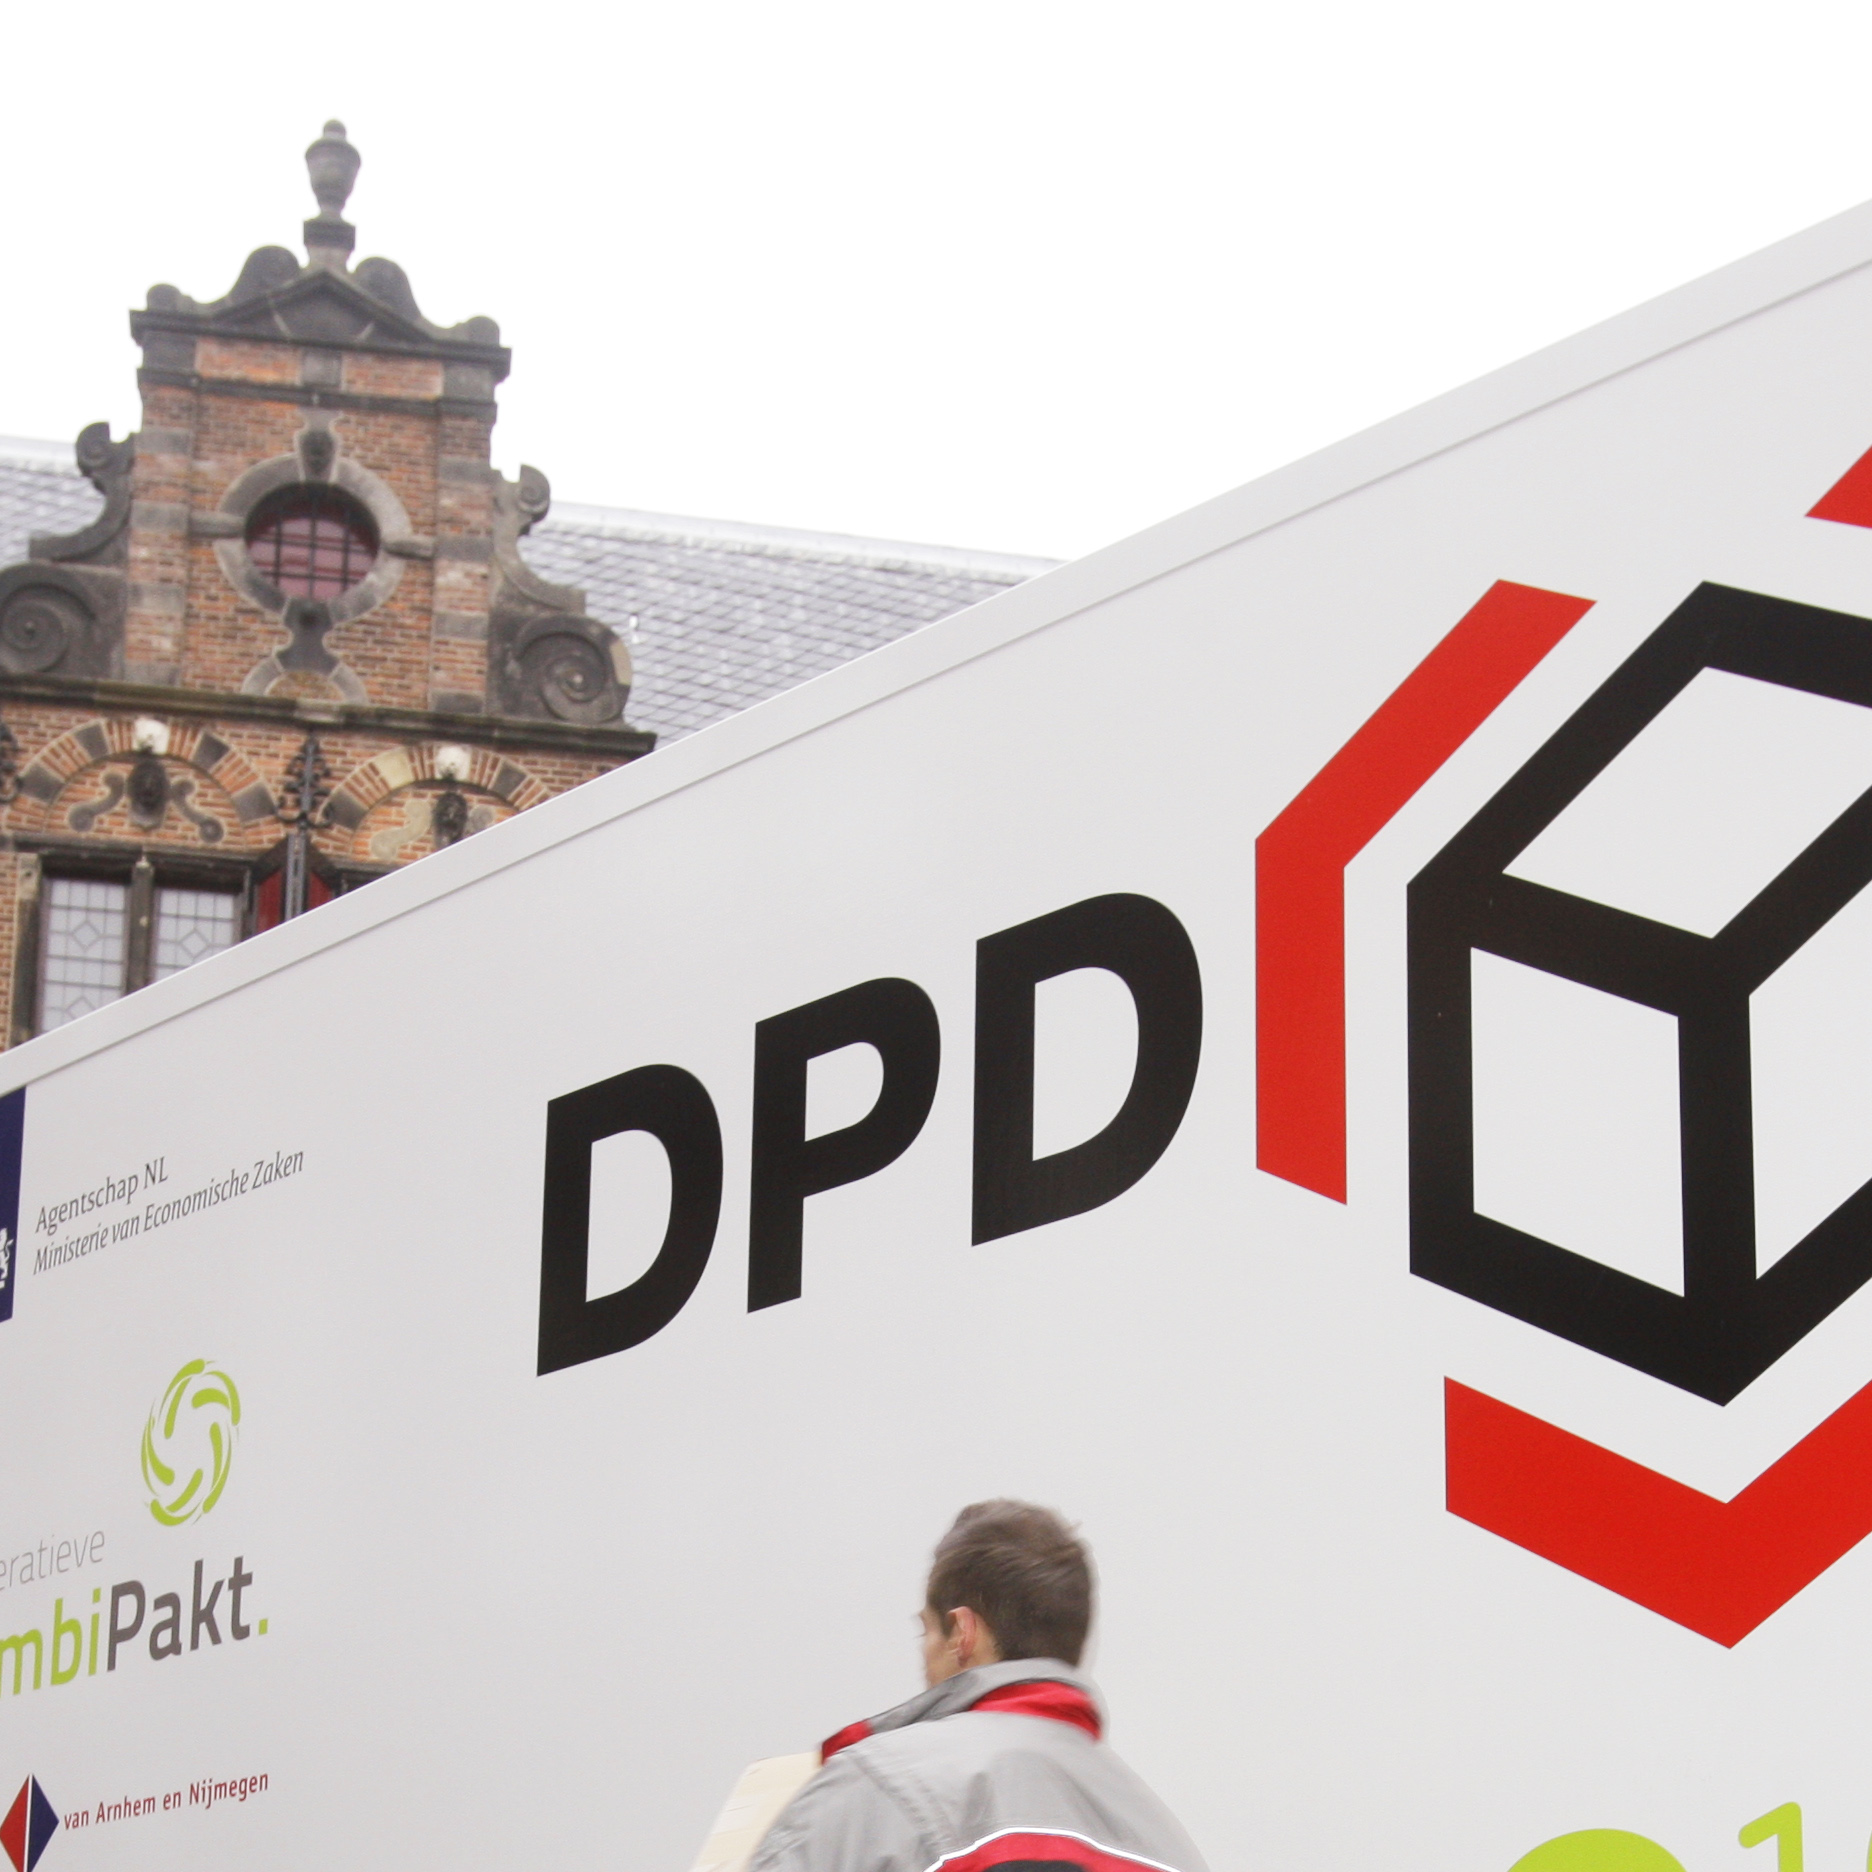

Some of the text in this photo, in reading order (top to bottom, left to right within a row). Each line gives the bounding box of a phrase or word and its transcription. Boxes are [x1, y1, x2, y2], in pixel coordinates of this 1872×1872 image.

[537, 892, 1203, 1378] DPD
[33, 1150, 305, 1275] Ministerie van Economische Zaken
[35, 1156, 169, 1237] Agentschap NL
[63, 1809, 90, 1831] van
[95, 1795, 157, 1824] Arnhem
[162, 1791, 182, 1811] en
[188, 1773, 269, 1810] Nijmegen
